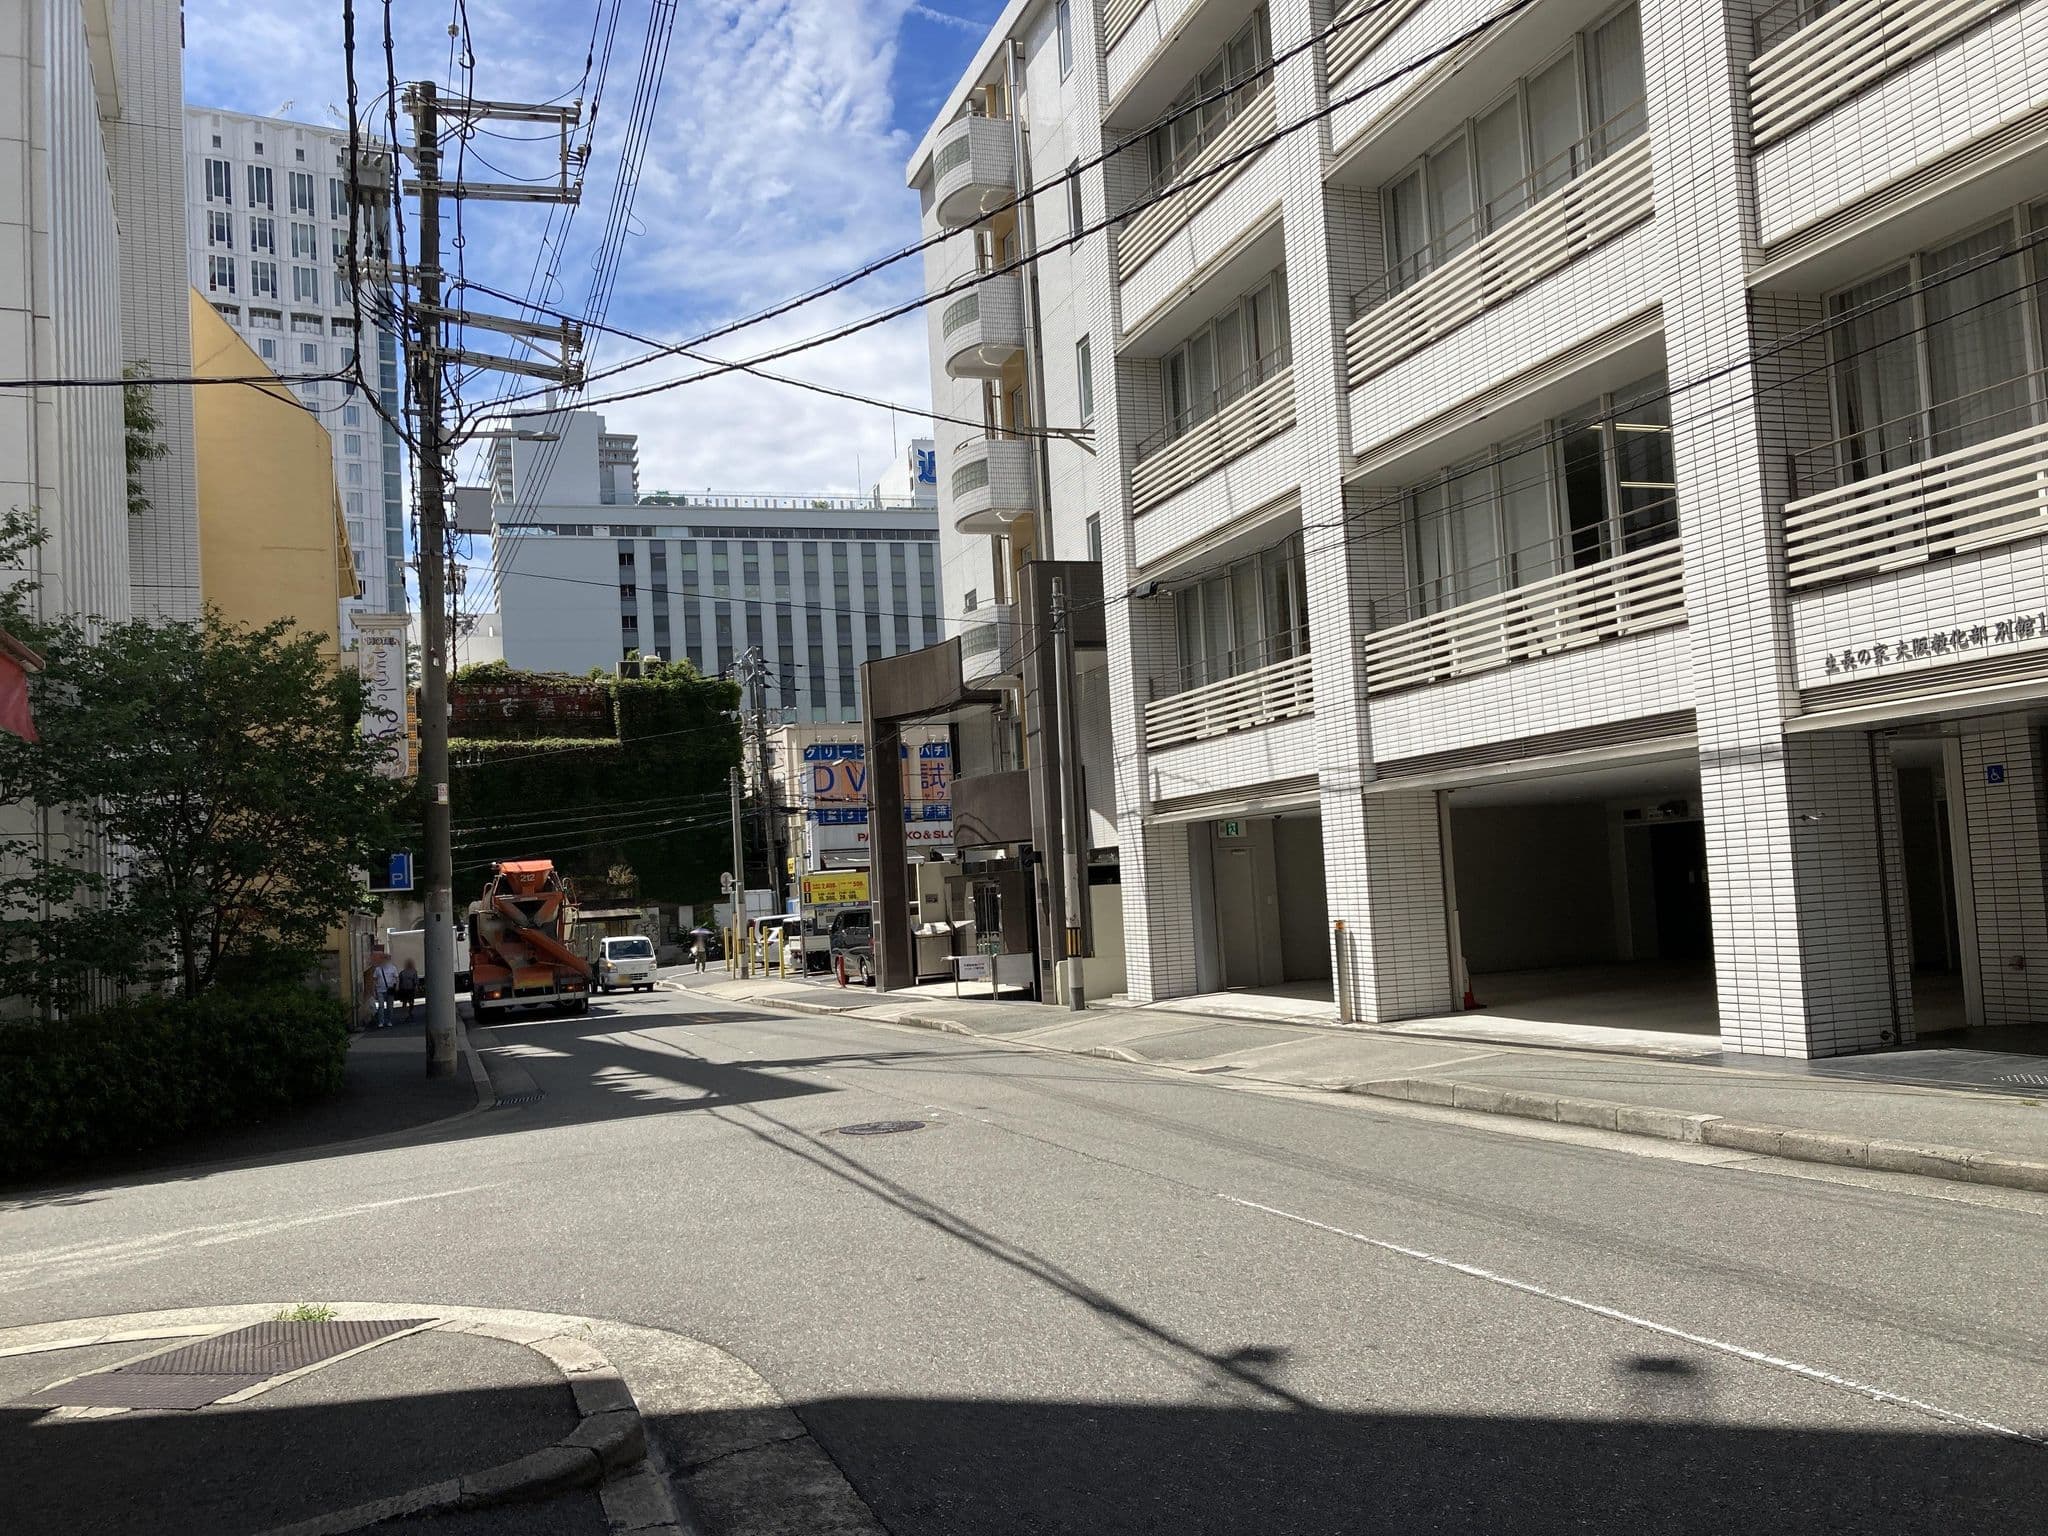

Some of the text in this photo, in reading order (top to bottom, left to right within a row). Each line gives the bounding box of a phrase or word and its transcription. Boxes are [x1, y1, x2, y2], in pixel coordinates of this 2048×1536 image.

[1825, 643, 1890, 675] 生長の家
[371, 650, 397, 702] purple
[392, 872, 403, 886] P
[520, 873, 536, 882] 212
